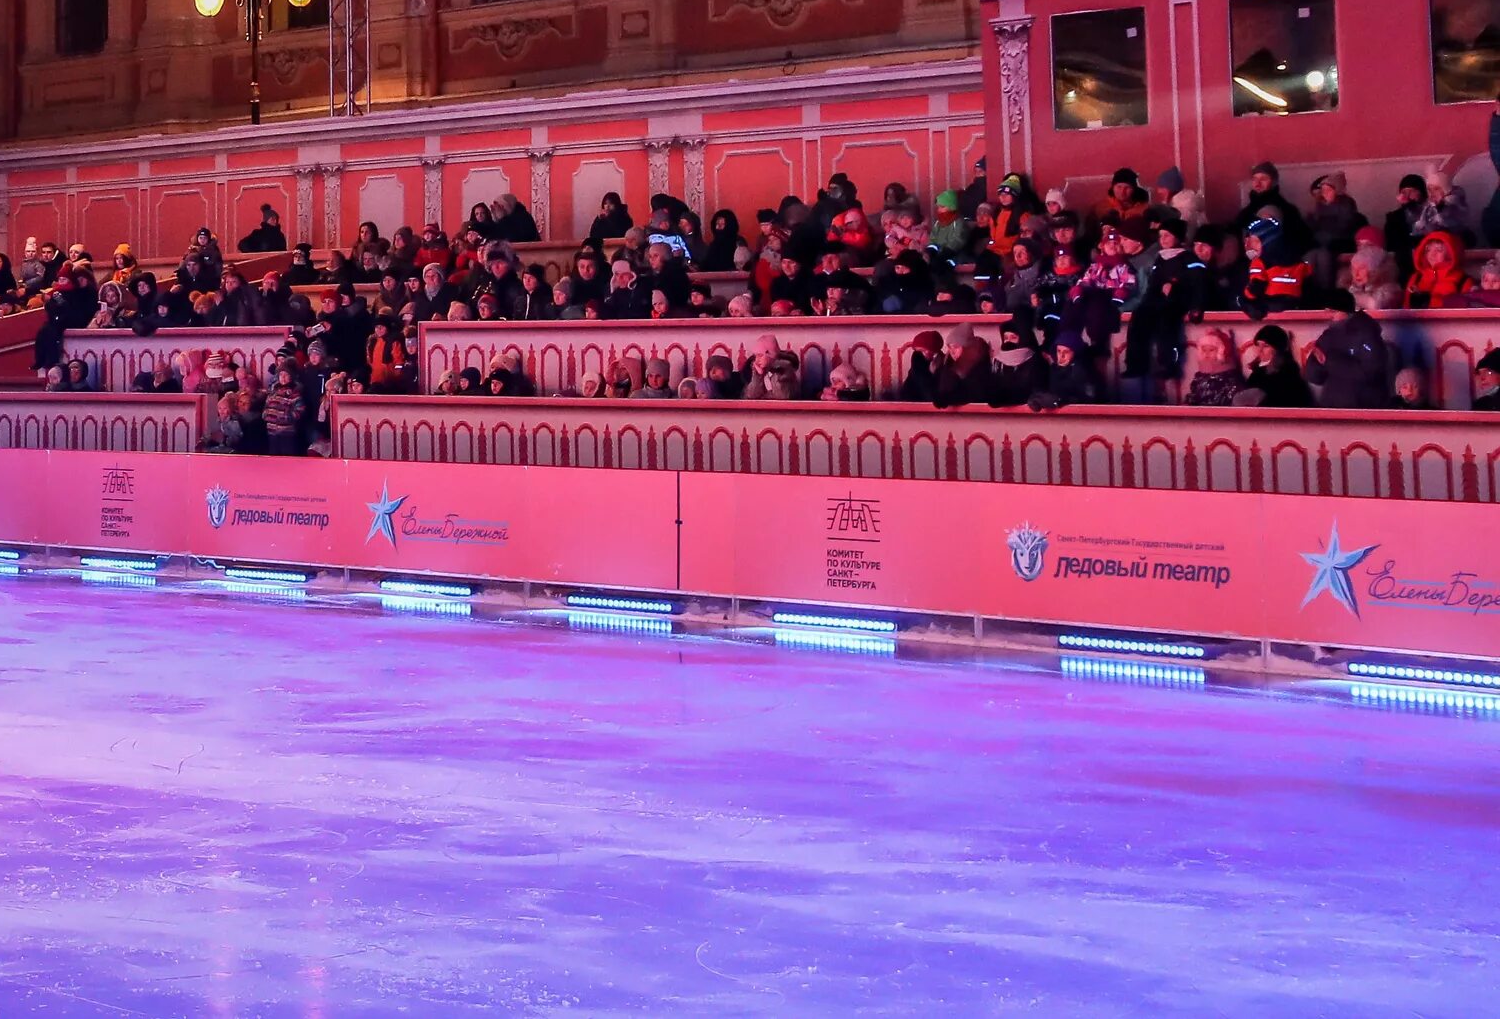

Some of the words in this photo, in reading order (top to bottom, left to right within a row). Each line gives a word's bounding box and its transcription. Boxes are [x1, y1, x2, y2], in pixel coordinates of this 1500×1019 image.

[286, 511, 329, 530] театр
[826, 549, 864, 559] КОМИТЕТ
[826, 559, 838, 568] ПО
[840, 560, 881, 570] КУЛЬТУРЕ
[1153, 561, 1231, 589] театр
[826, 579, 876, 590] ПЕТЕРБУРГА
